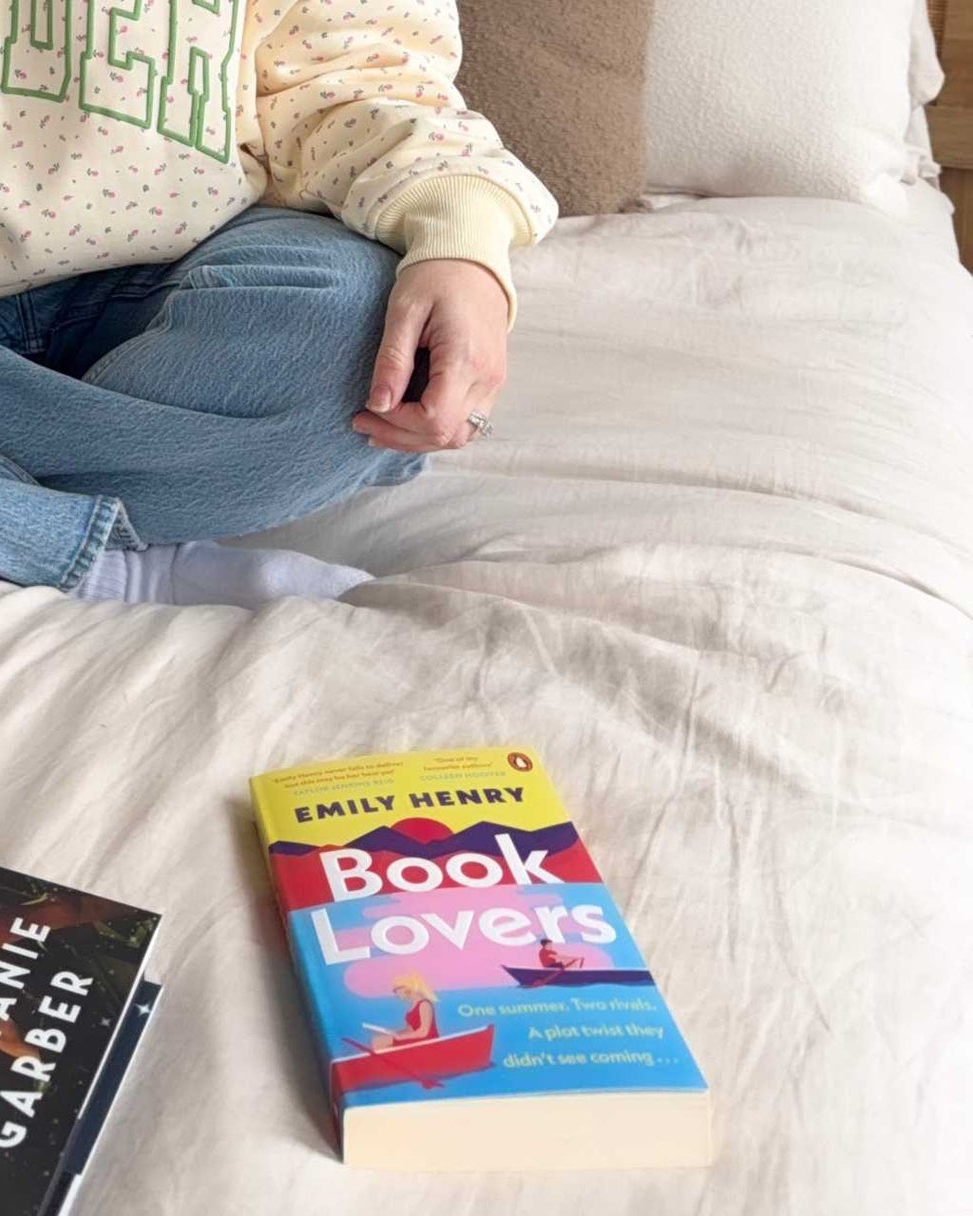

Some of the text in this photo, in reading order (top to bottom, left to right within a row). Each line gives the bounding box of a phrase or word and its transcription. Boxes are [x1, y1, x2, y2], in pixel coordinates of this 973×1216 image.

[294, 787, 524, 823] EMILY HENRY
[319, 833, 566, 902] Book
[310, 903, 617, 965] Lovers
[457, 997, 657, 1016] One summer. Two rivals.
[529, 1023, 664, 1042] A plot twist they
[503, 1052, 555, 1068] didn't
[557, 1054, 587, 1065] see
